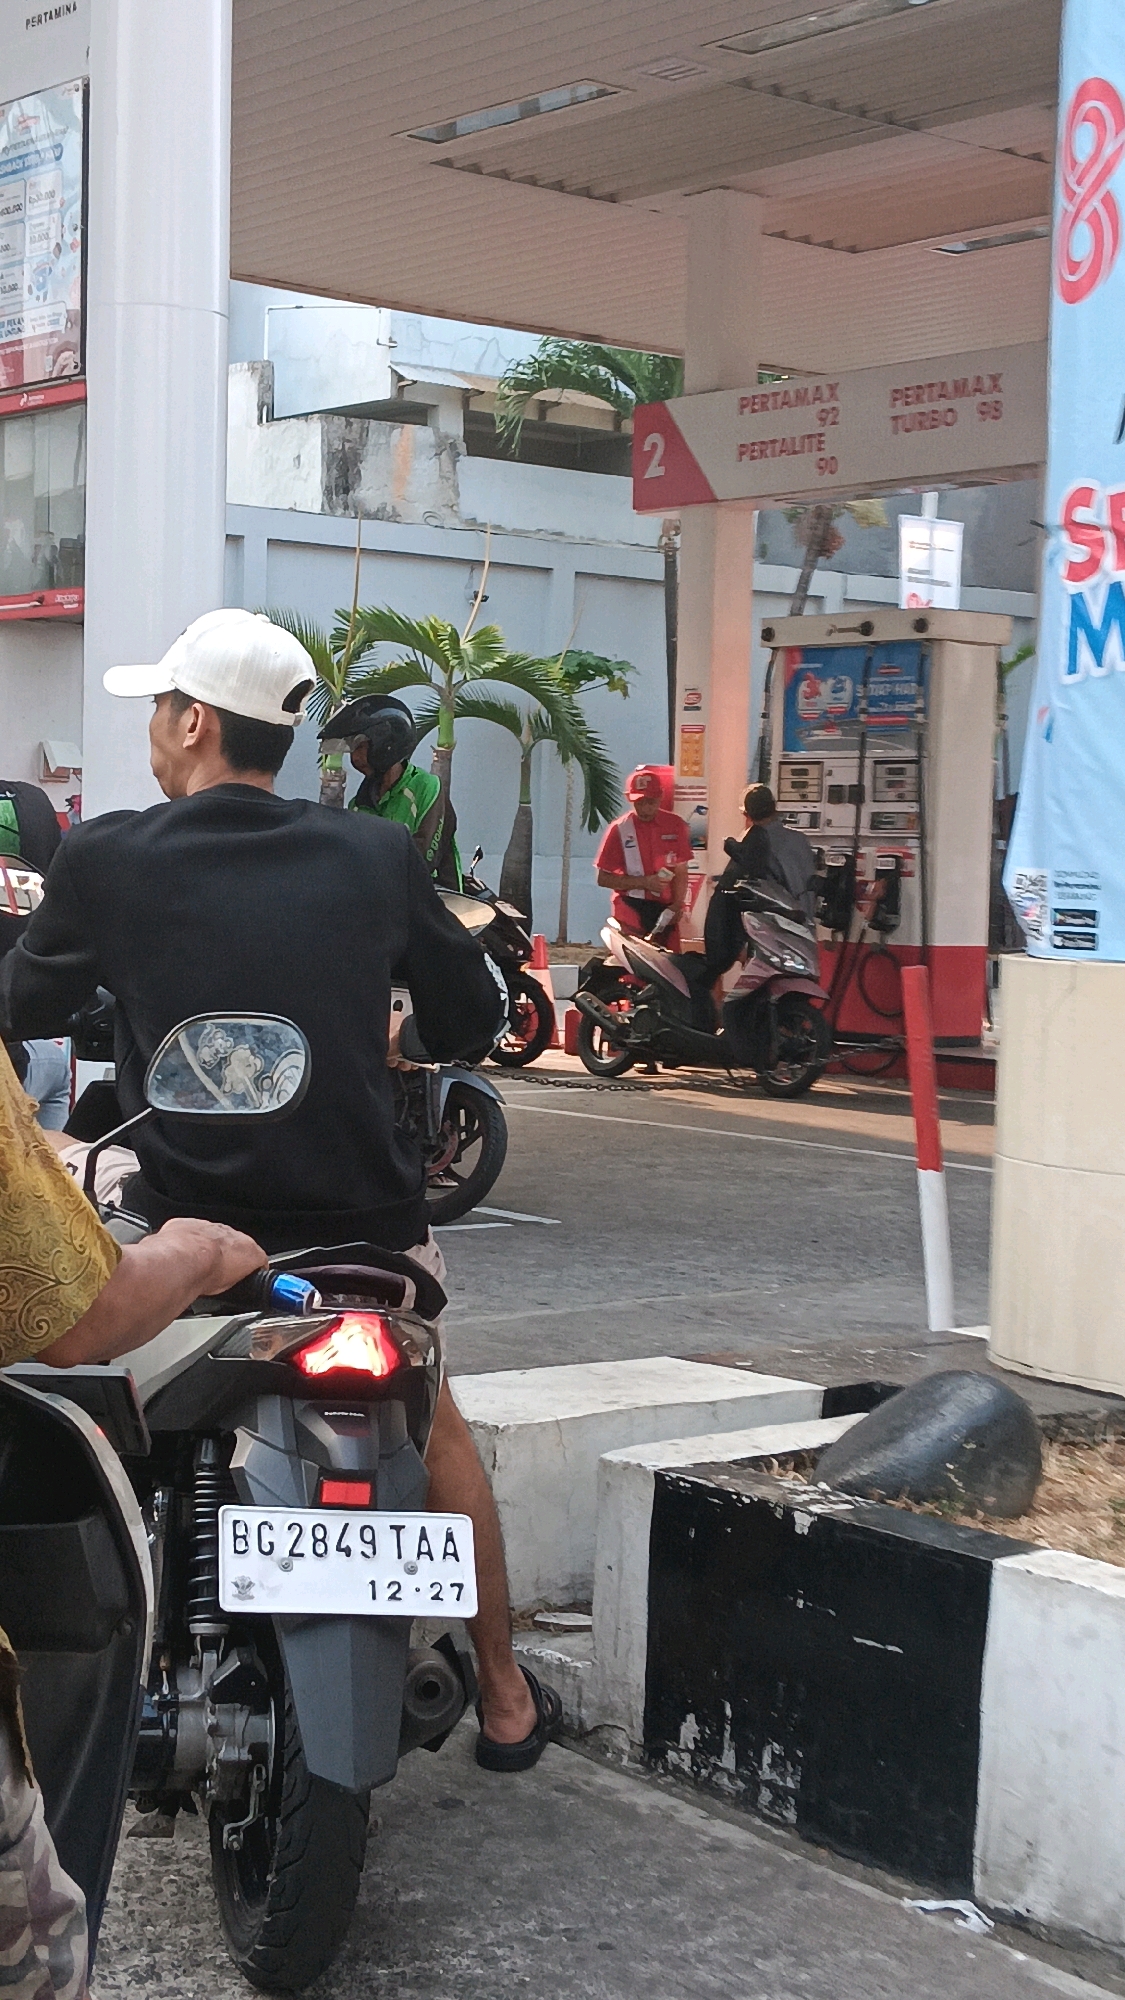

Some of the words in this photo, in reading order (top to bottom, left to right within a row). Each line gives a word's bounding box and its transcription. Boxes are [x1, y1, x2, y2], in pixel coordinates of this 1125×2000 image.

[25, 1, 78, 31] PERTAMINA
[738, 382, 840, 415] PERTAMAX
[888, 373, 1004, 408] PERTAMAX
[816, 406, 840, 427] 92
[890, 407, 958, 435] TURBO
[976, 400, 1004, 422] 98
[643, 432, 666, 479] 2
[737, 432, 826, 462] PERTALITE
[816, 455, 839, 476] 90
[232, 1519, 275, 1556] BG
[287, 1522, 377, 1559] 2849
[389, 1524, 460, 1562] TAA
